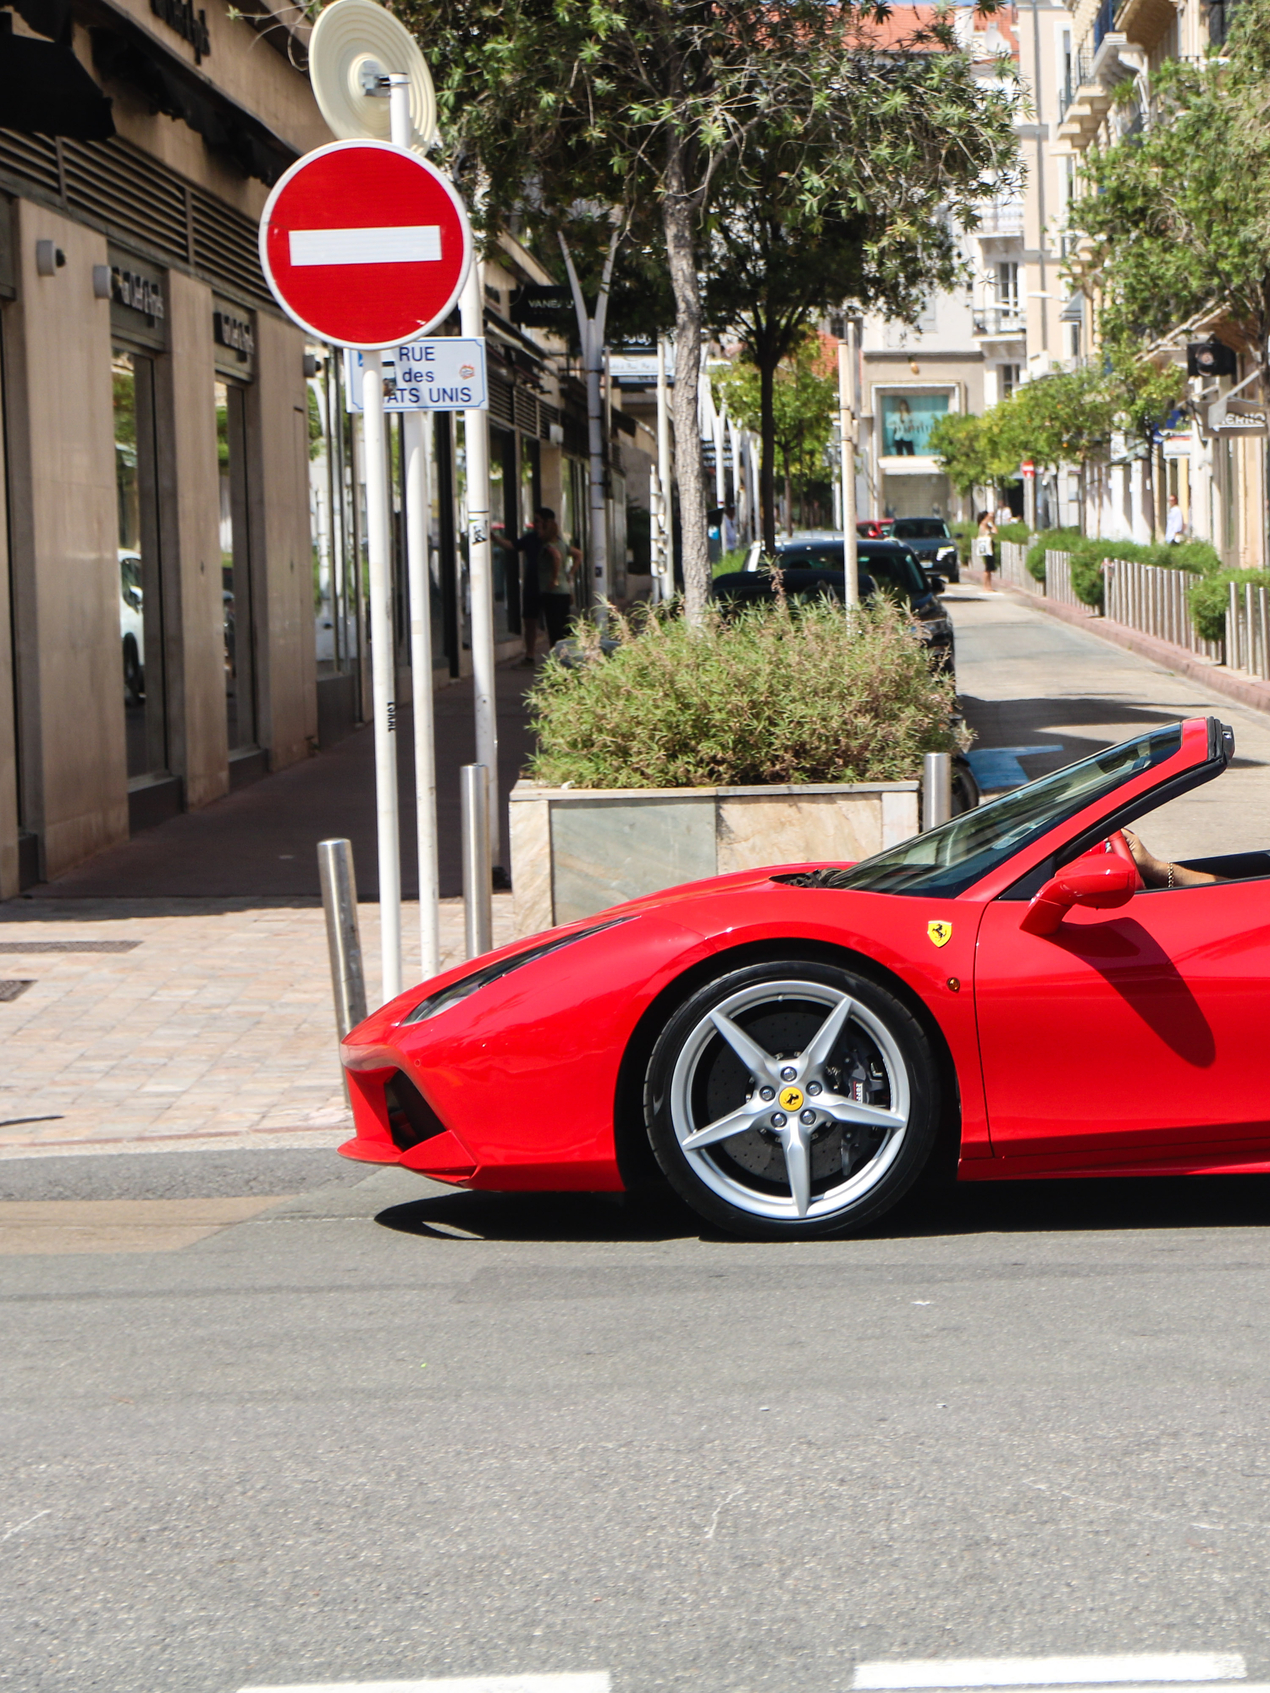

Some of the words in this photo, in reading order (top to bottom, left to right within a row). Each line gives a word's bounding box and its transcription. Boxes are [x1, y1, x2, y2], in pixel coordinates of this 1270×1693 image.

[399, 346, 436, 362] RUE
[402, 368, 435, 383] des
[429, 387, 472, 403] UNIS
[1221, 411, 1266, 425] ERNO
[855, 1083, 863, 1103] Ferr
